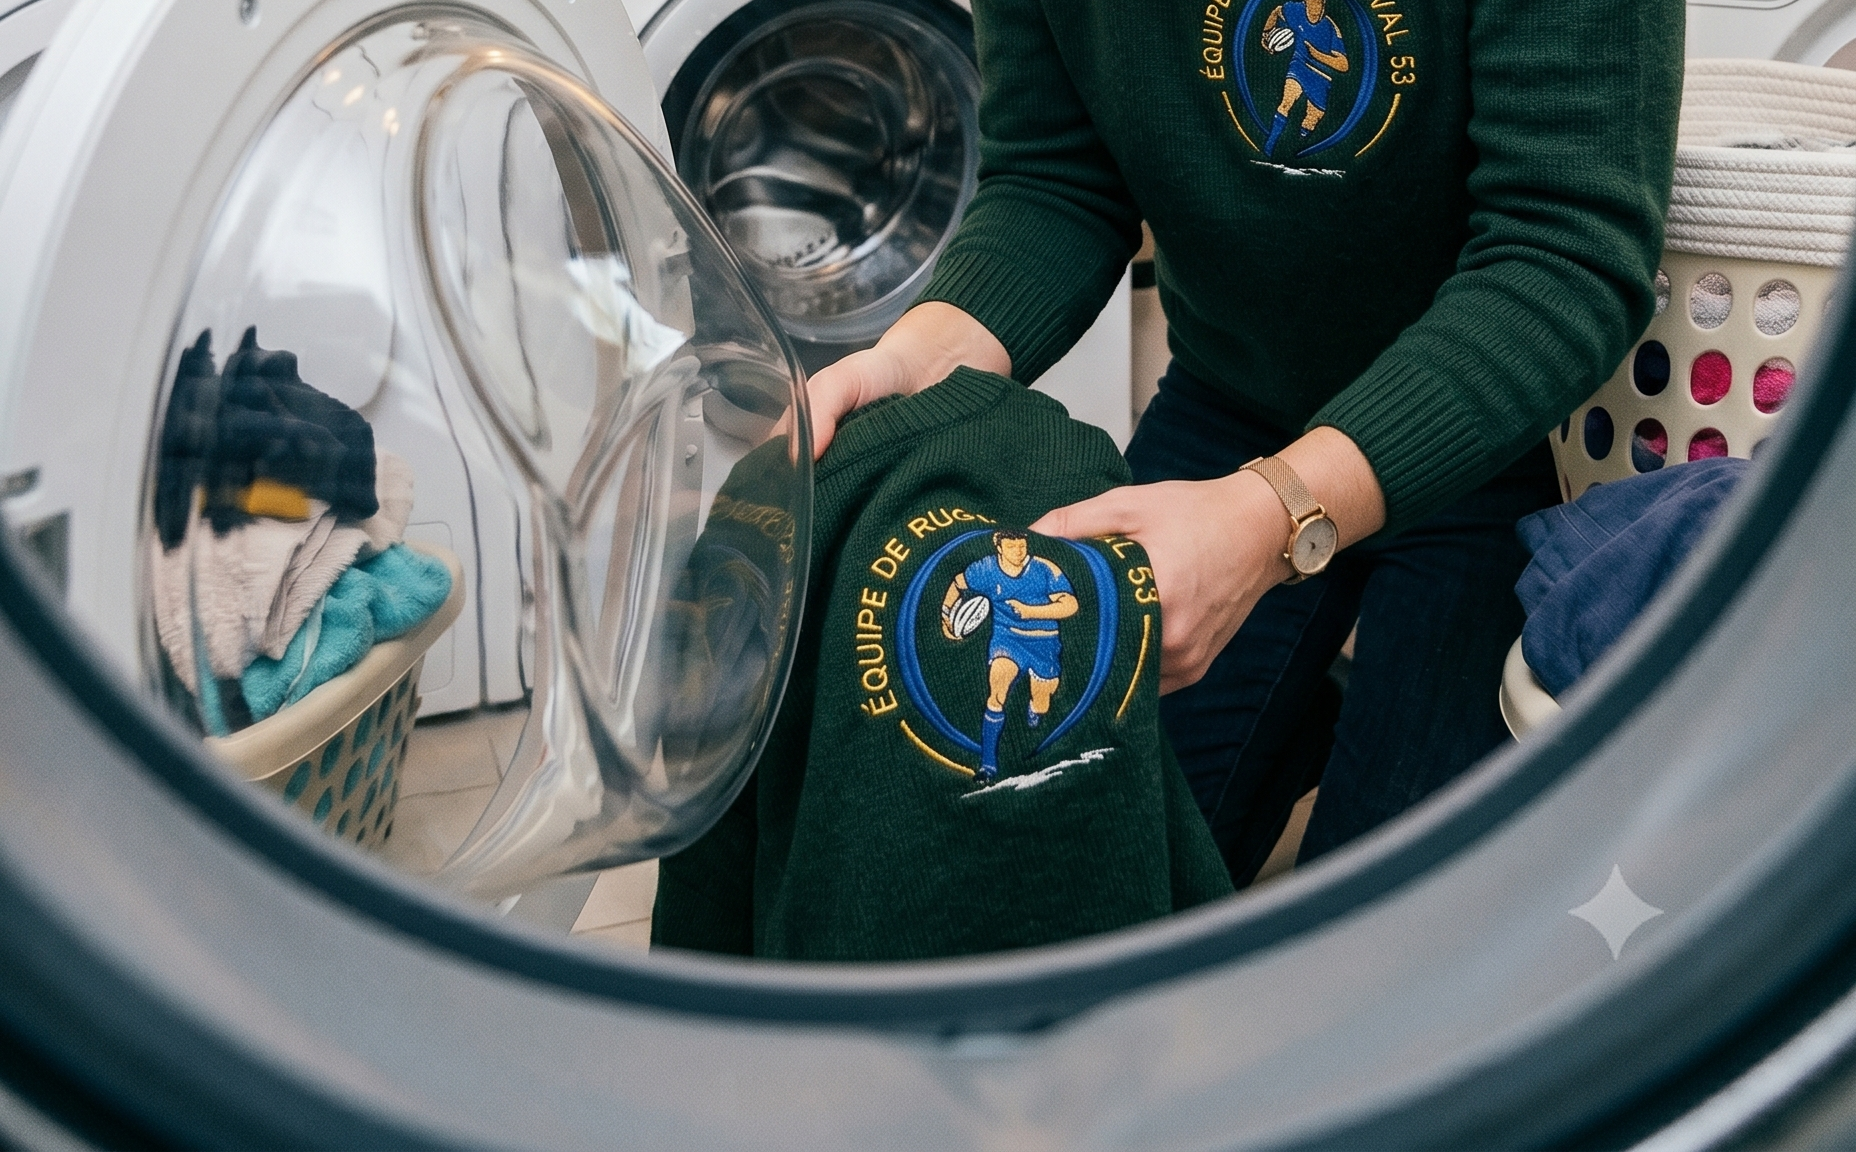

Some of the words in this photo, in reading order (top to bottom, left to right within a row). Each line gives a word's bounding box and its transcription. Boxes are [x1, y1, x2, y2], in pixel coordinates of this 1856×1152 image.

[1390, 56, 1416, 85] 53
[871, 537, 911, 579] DE
[1127, 566, 1159, 604] 53
[856, 587, 898, 716] ÉQUIPE
